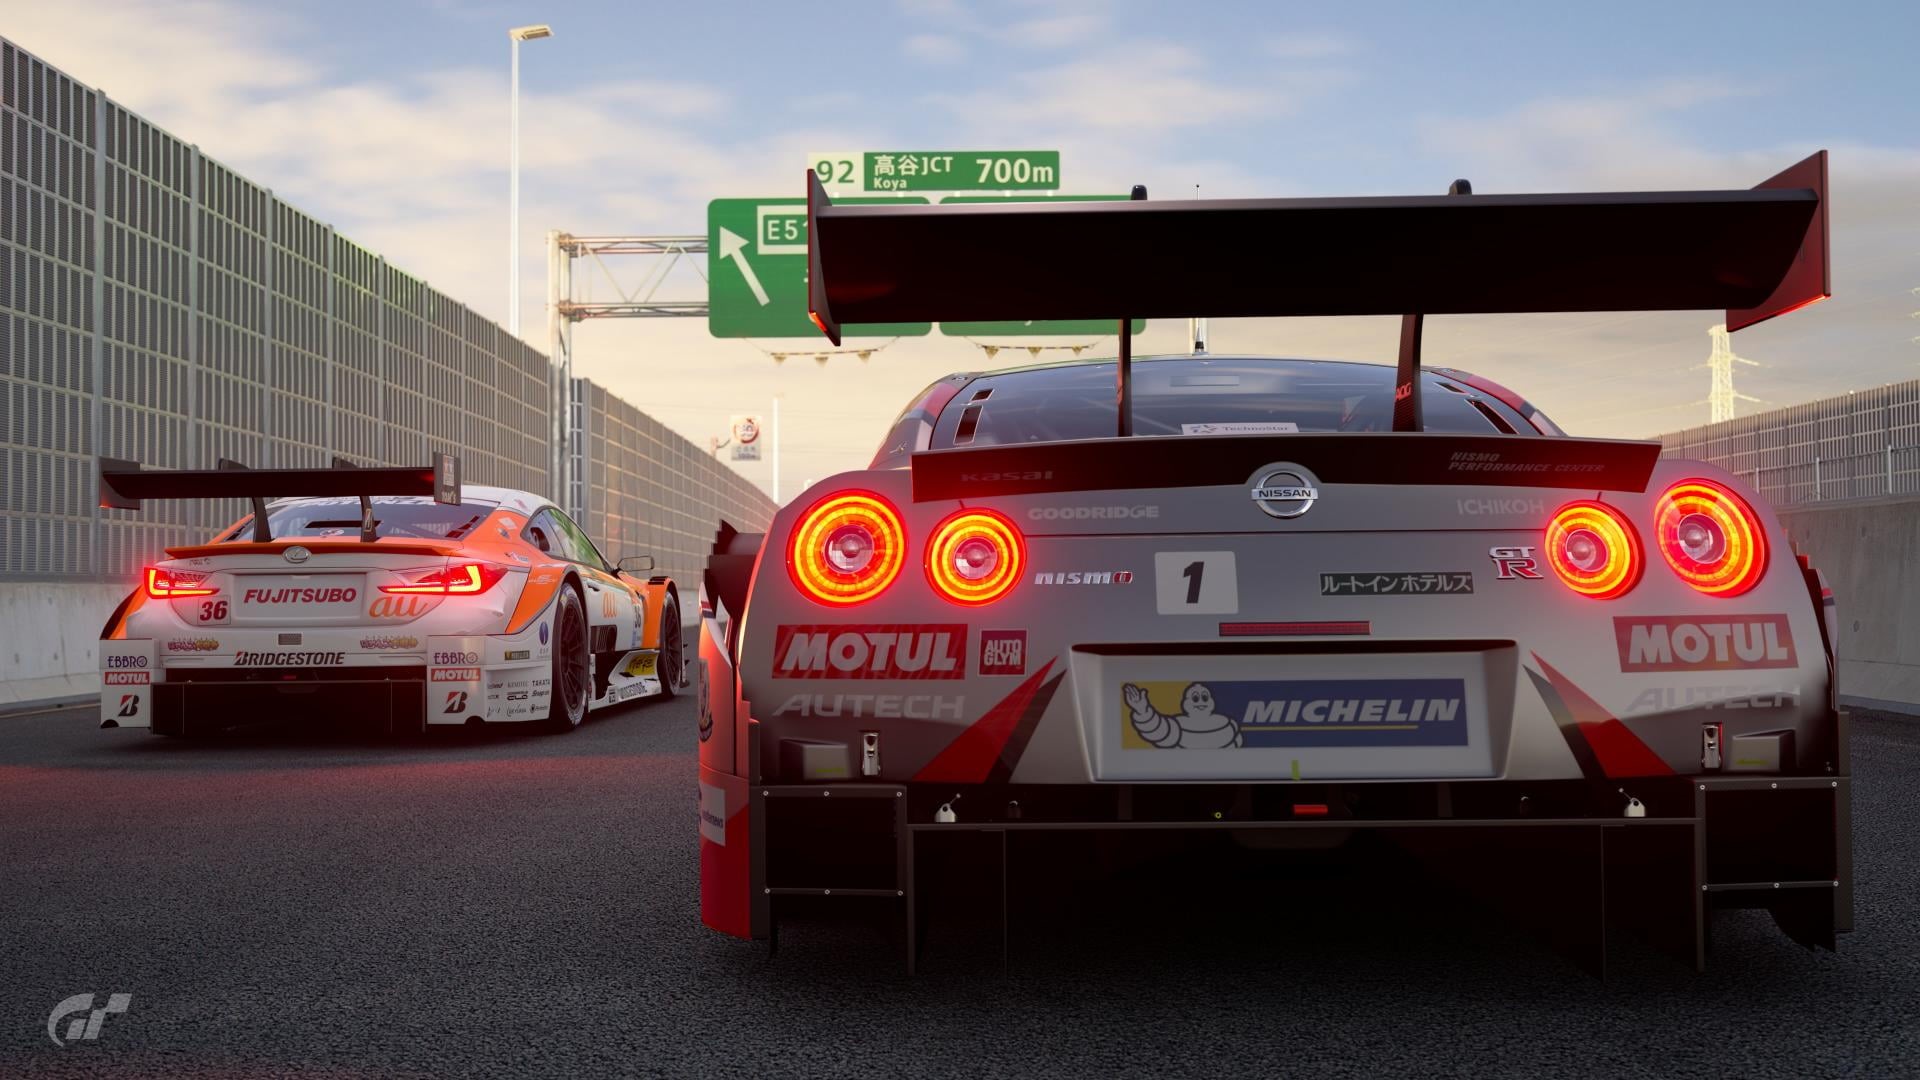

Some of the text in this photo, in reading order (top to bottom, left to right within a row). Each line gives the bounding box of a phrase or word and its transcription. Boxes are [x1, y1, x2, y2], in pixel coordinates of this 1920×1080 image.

[817, 160, 855, 184] 92
[873, 154, 1053, 183] 高谷JCT 700m
[874, 177, 907, 191] Koya
[767, 219, 808, 240] E5
[1450, 452, 1501, 462] NISMO
[1448, 462, 1605, 472] PERFORMANCE CENTER
[1258, 489, 1312, 498] NISSAN
[1028, 505, 1160, 520] GOODRIDGE
[1457, 499, 1545, 515] ICHIKOH
[1182, 561, 1205, 604] 1
[244, 588, 357, 603] FUJITSUBO
[200, 601, 228, 621] 36
[369, 596, 428, 618] au
[985, 639, 1022, 652] AUTO
[1628, 622, 1788, 664] MOTUL
[234, 651, 345, 666] BRIDGESTONE
[434, 652, 478, 664] EBBRO
[781, 632, 957, 671] MOTUL
[984, 651, 1021, 666] GLYM
[108, 655, 148, 668] EBBRO
[107, 673, 148, 684] MOTUL
[432, 669, 480, 681] MOTUL
[772, 694, 965, 718] AUTECH
[1242, 698, 1460, 723] MICHELIN
